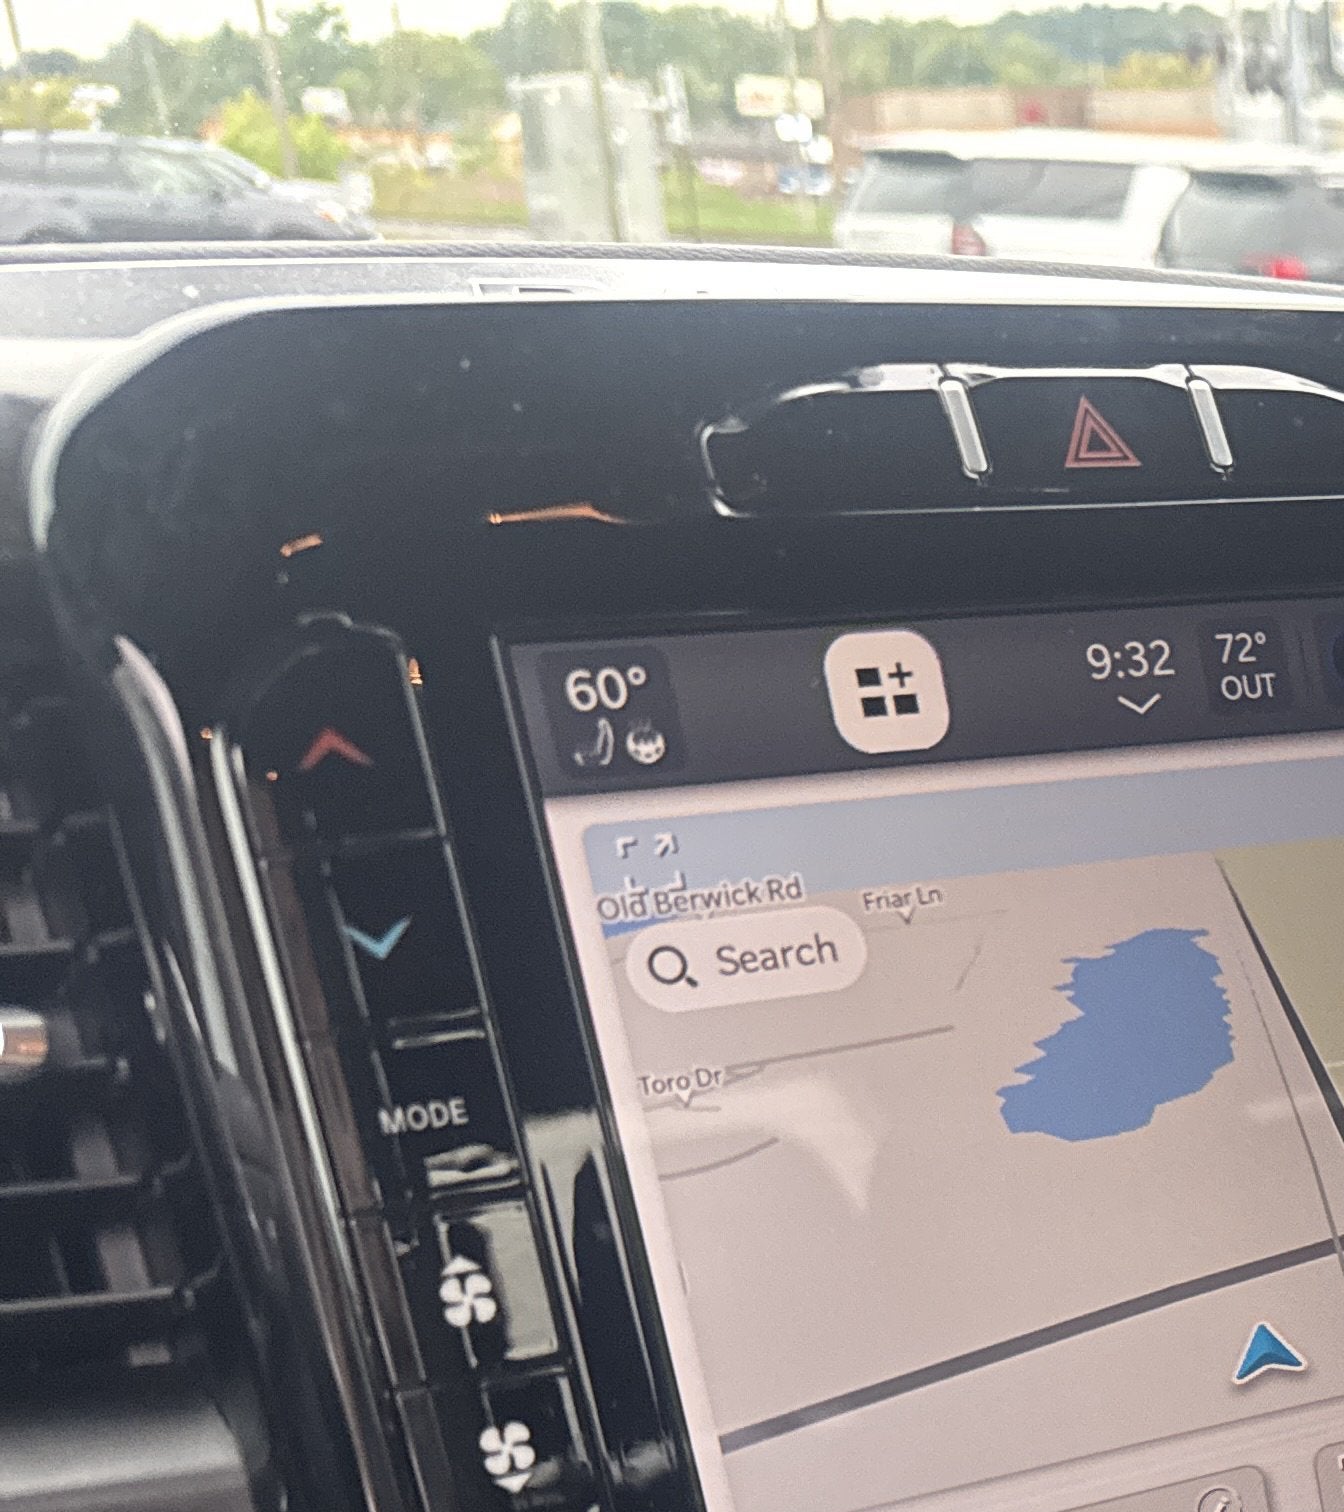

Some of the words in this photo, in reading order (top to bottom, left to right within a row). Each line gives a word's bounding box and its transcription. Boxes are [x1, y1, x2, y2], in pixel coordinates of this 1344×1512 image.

[1086, 640, 1175, 679] 9:32
[1215, 632, 1267, 663] 72°
[566, 666, 647, 712] 60°
[1221, 672, 1276, 700] OUT
[598, 891, 648, 922] Old
[653, 882, 763, 915] Berwick
[768, 876, 803, 902] Rd
[863, 890, 912, 912] Friar
[918, 886, 943, 906] Ln
[717, 933, 839, 977] Search
[640, 1075, 691, 1096] Toro
[695, 1068, 724, 1086] Dr
[378, 1097, 470, 1136] MODE
